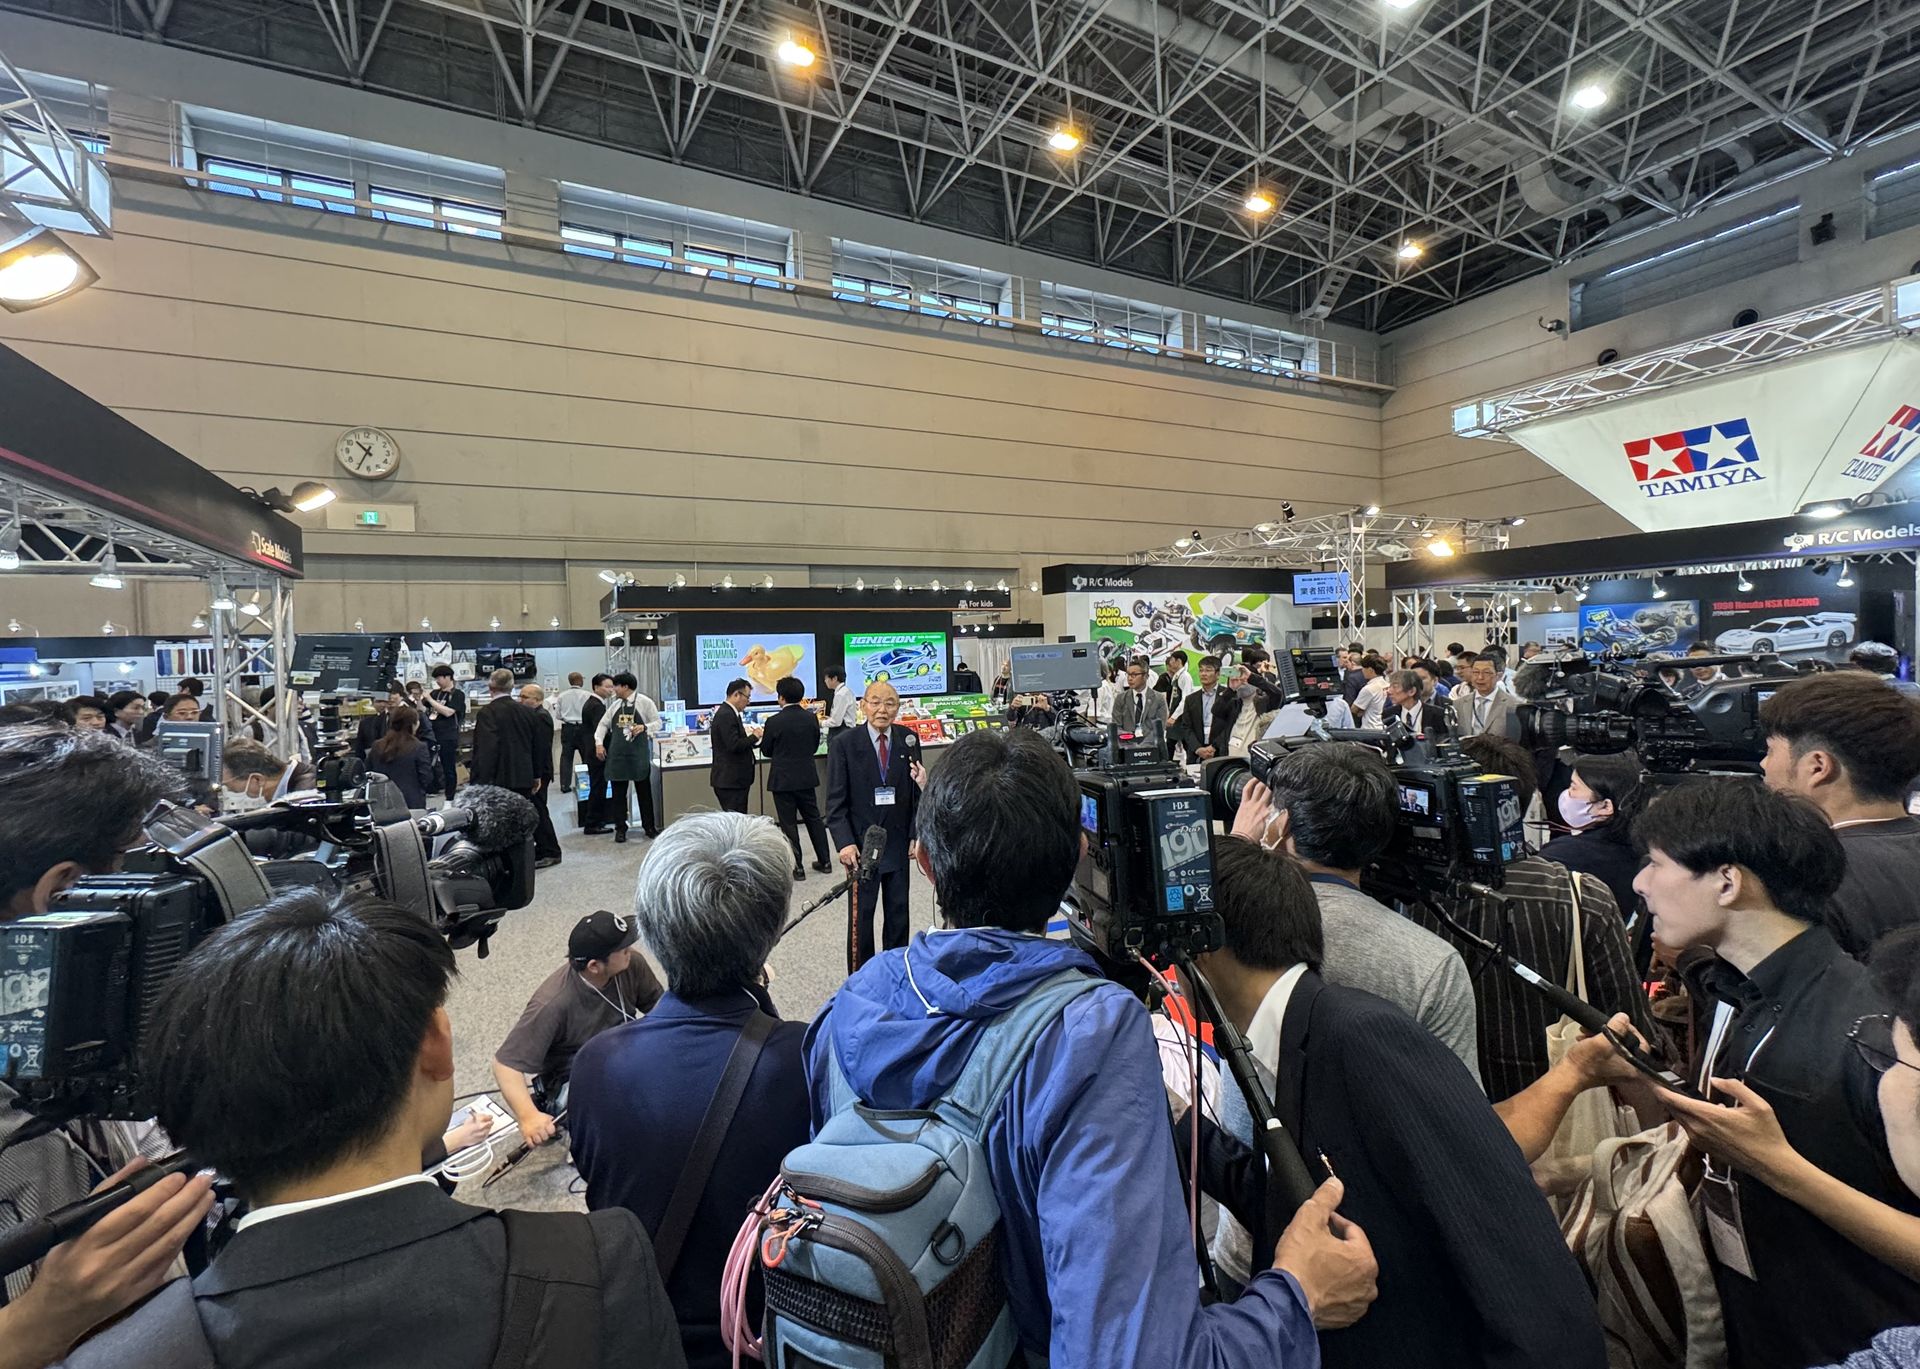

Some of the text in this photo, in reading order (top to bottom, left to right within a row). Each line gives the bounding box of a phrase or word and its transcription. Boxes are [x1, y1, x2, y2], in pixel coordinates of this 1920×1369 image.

[1841, 458, 1886, 482] TAMIYA
[1639, 467, 1766, 497] TAMIYA
[1818, 524, 1920, 545] R/C Models
[261, 537, 275, 558] Scale
[1089, 578, 1134, 586] R/C Models
[1096, 607, 1120, 616] RADIO
[1096, 616, 1132, 627] CONTROL
[703, 638, 730, 648] WALKING
[850, 636, 916, 644] IGNICION
[703, 649, 738, 659] SWIMMING
[704, 660, 720, 670] DUCK
[1160, 820, 1210, 870] 190
